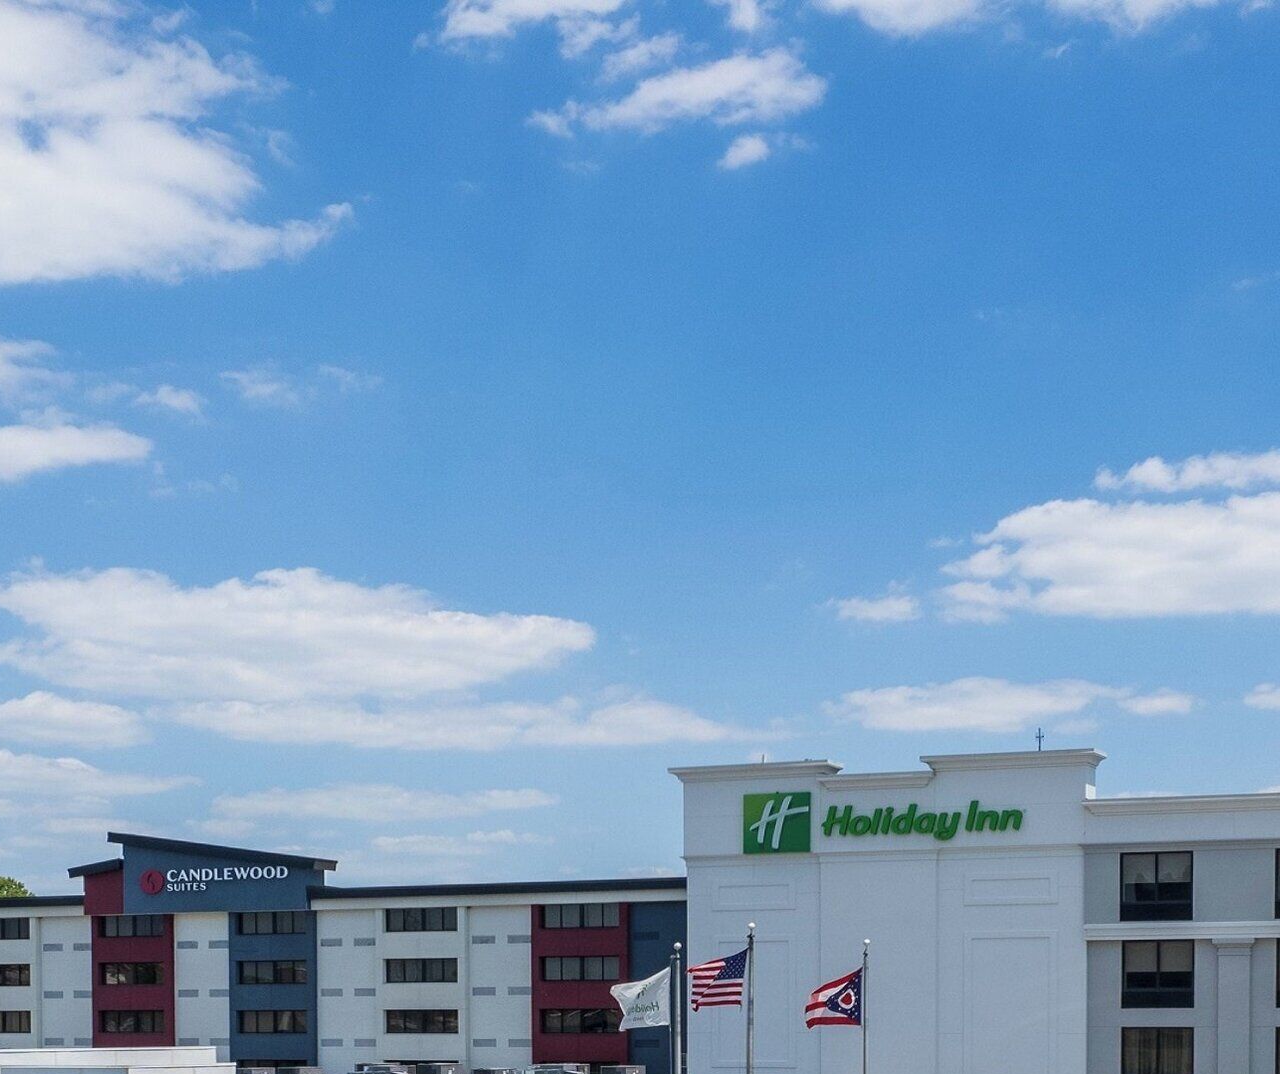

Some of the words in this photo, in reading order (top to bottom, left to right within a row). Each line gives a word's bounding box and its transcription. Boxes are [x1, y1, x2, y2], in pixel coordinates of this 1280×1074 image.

[821, 803, 961, 841] Holiday
[965, 800, 1023, 832] Inn
[166, 866, 289, 882] CANDLEWOOD
[166, 882, 207, 892] SUITES
